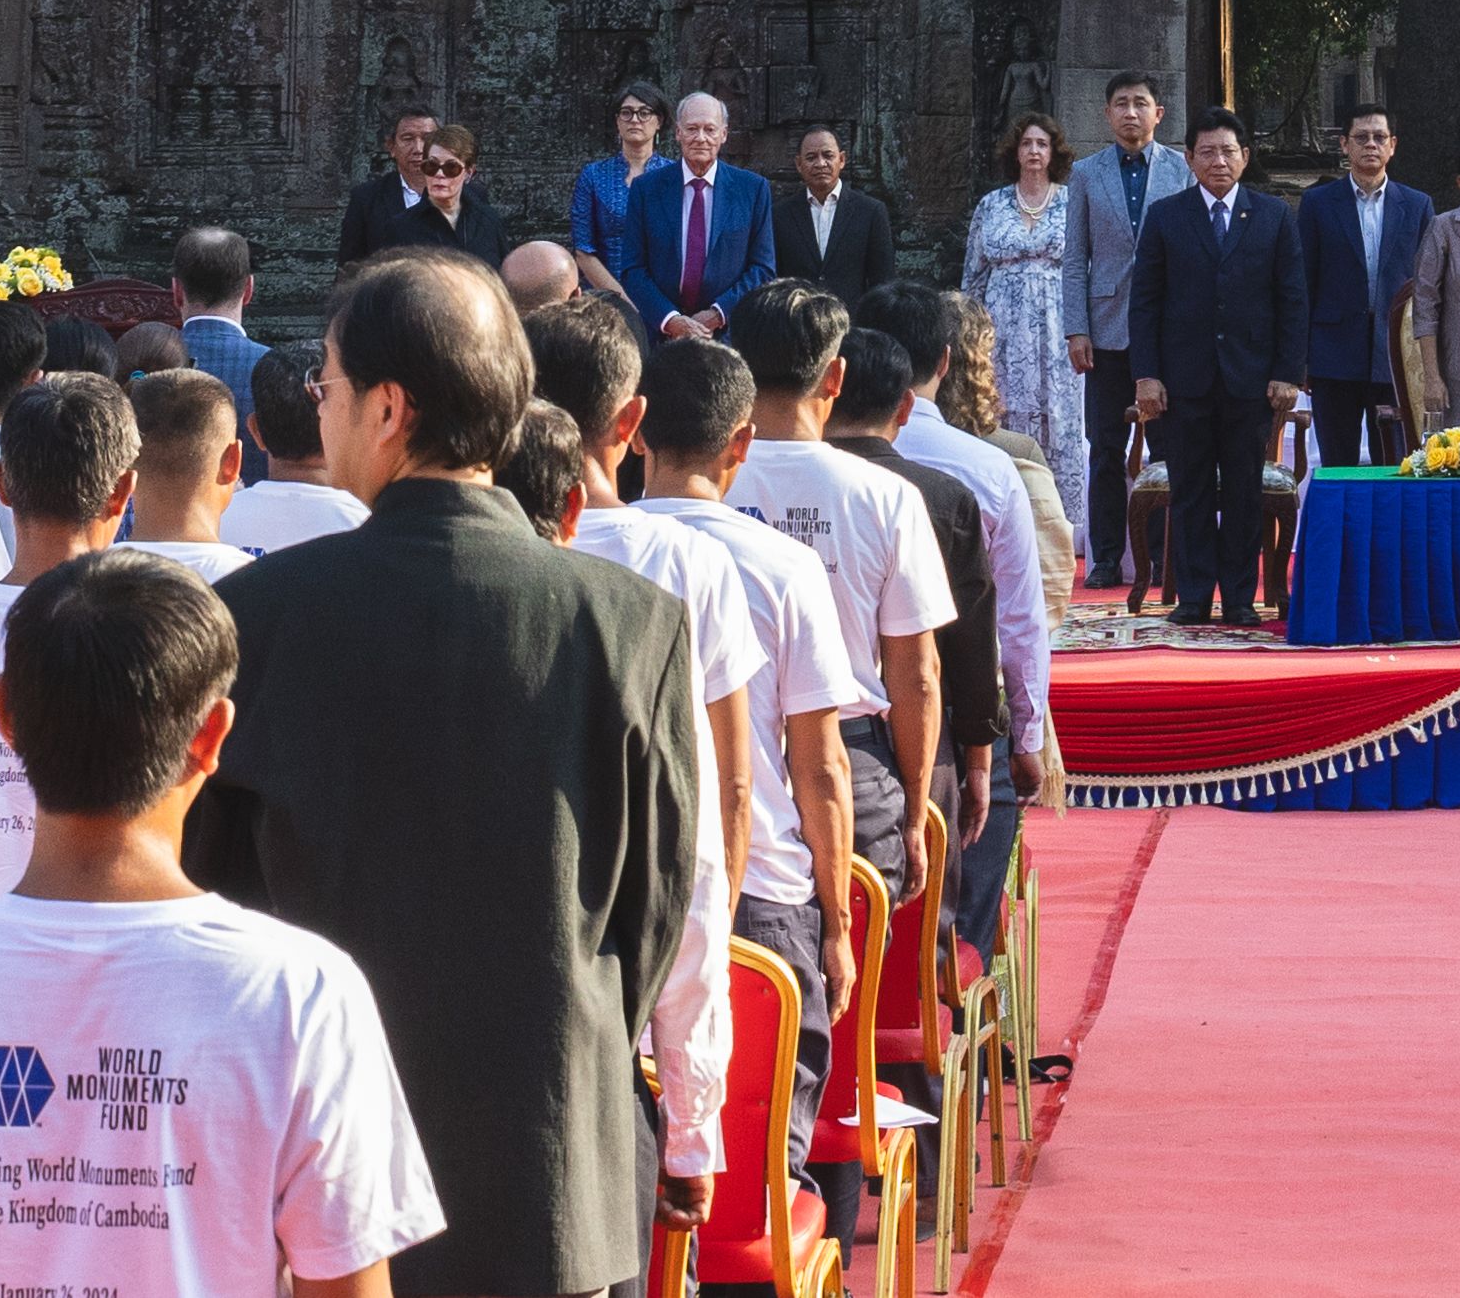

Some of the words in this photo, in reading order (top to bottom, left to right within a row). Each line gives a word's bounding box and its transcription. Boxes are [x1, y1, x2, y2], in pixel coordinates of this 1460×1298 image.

[773, 520, 831, 534] MONUMENTS
[786, 507, 819, 520] WORLD
[790, 534, 813, 546] ND
[12, 815, 25, 833] 26,
[98, 1047, 162, 1075] WORLD
[66, 1074, 188, 1105] MONUMENTS
[100, 1104, 148, 1131] FUND
[27, 1157, 75, 1183] World
[79, 1159, 158, 1187] Monuments
[8, 1197, 77, 1230] Kingdom
[79, 1201, 94, 1225] of
[95, 1201, 169, 1230] Cambodia
